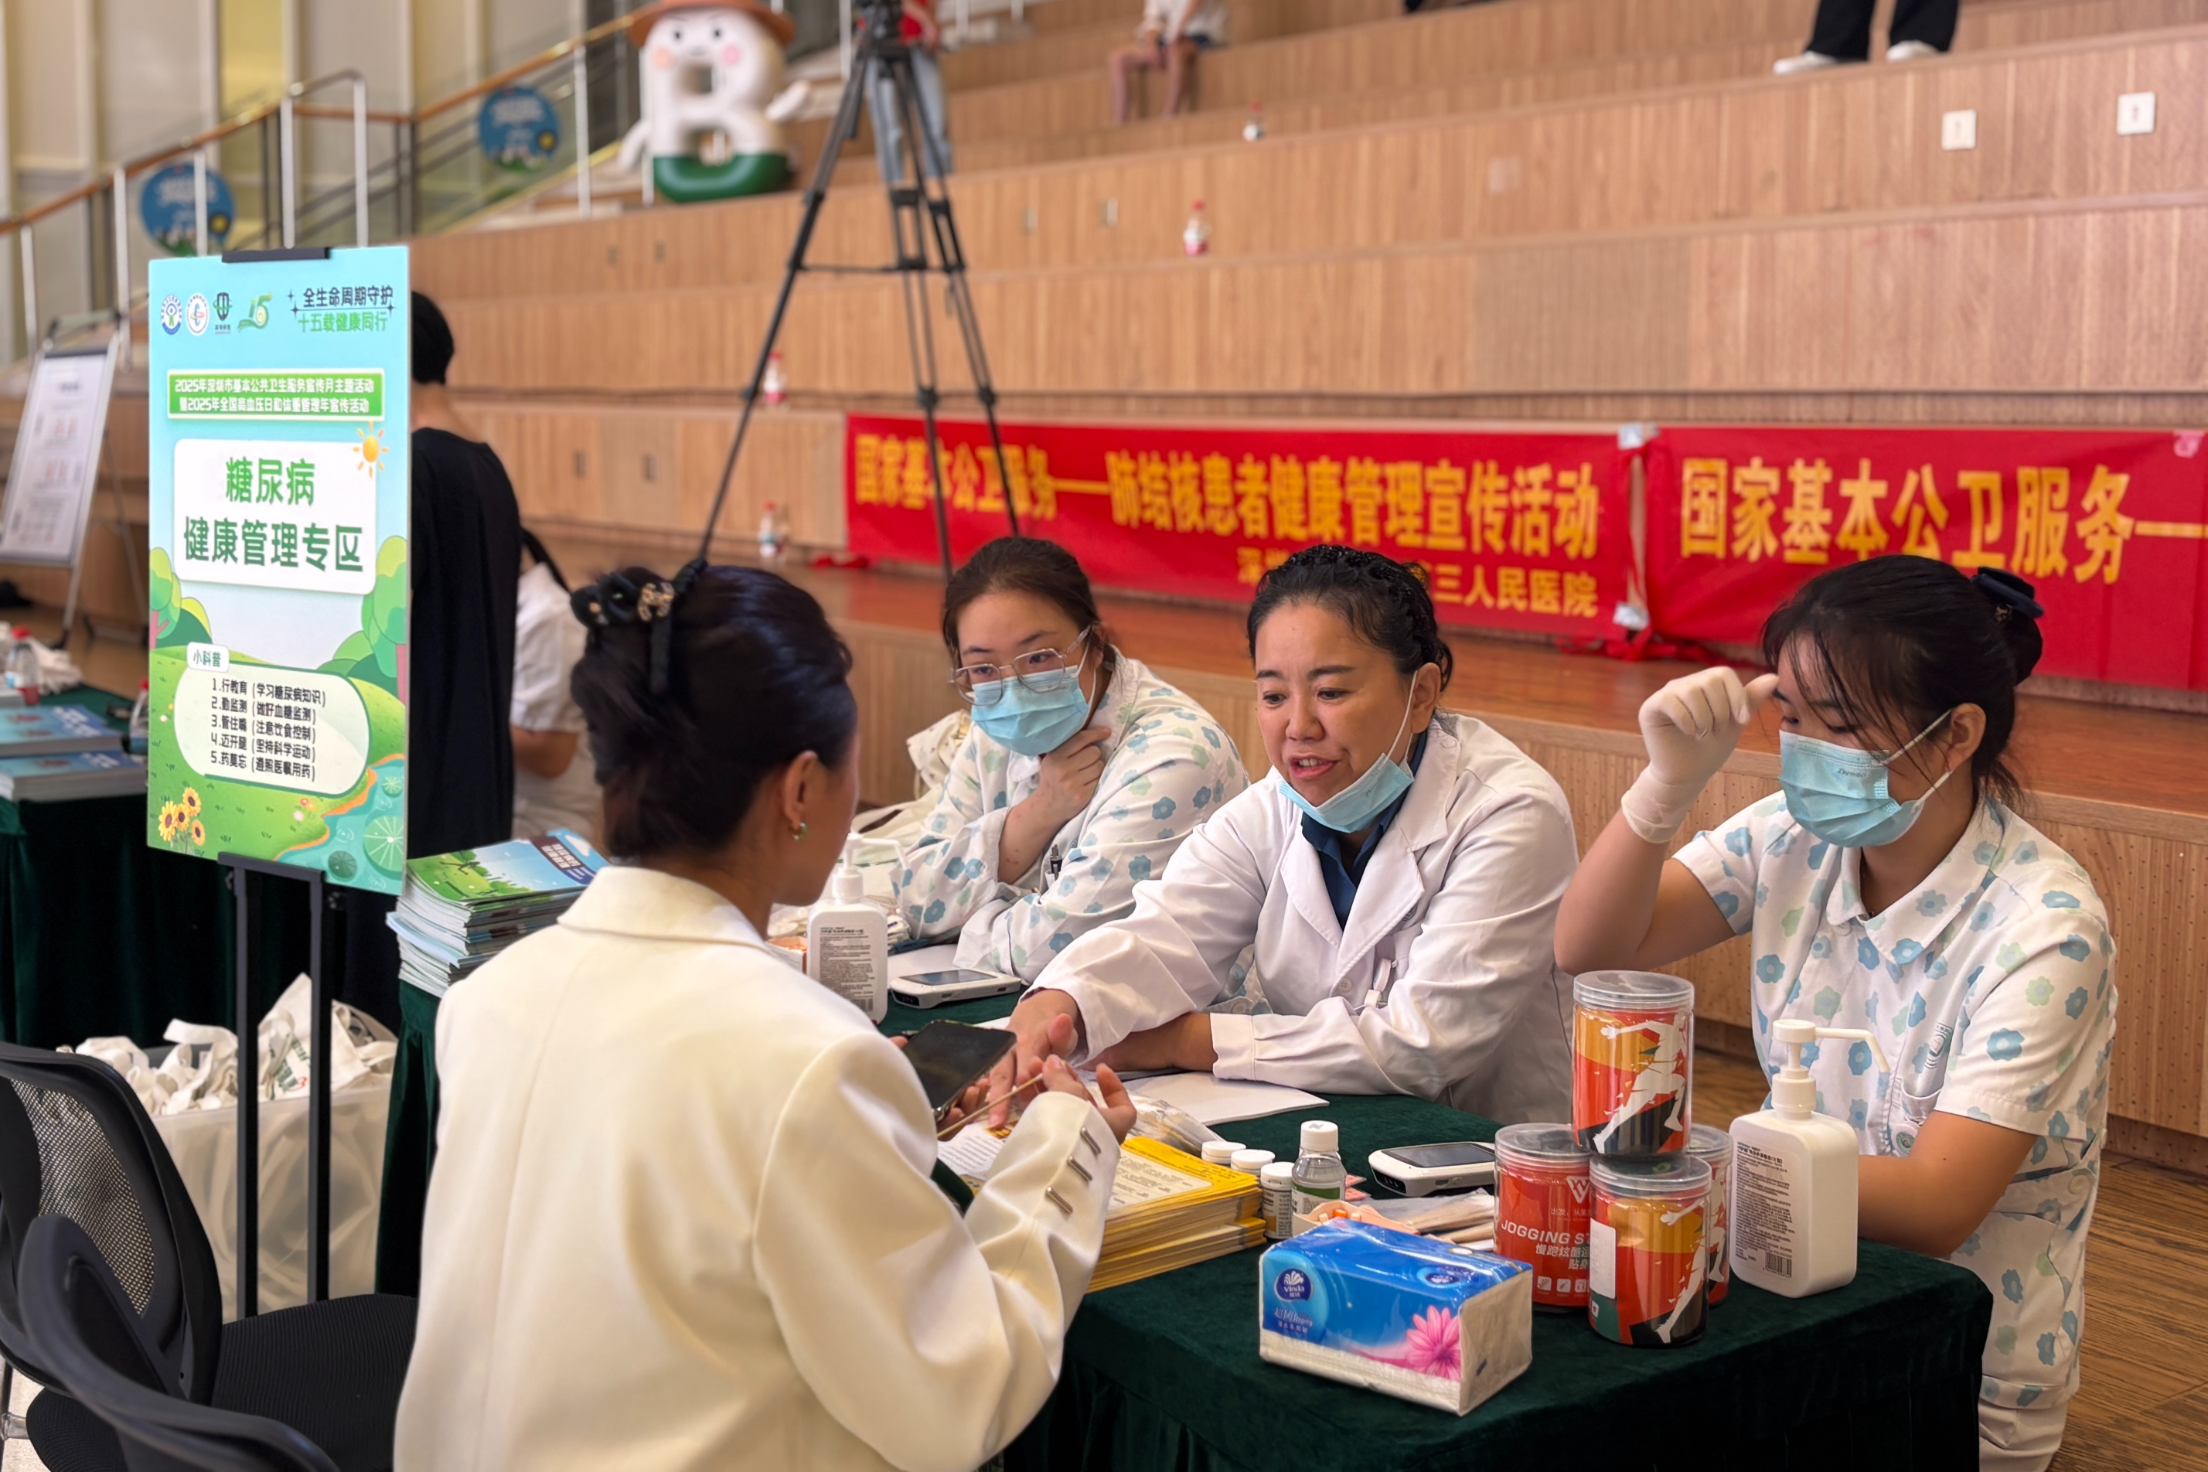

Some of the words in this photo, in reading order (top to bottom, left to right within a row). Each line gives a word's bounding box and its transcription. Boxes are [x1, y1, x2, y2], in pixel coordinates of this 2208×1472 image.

[303, 284, 394, 308] 全生命周期守护
[297, 311, 388, 333] 十五载健康同行
[174, 377, 375, 394] 2025年深圳市基本公共卫生服务宣传月主题活动
[225, 456, 316, 506] 糖尿病
[183, 515, 364, 573] 健康管理专区
[193, 649, 221, 668] 小科普
[1501, 1219, 1570, 1245] JOGGING
